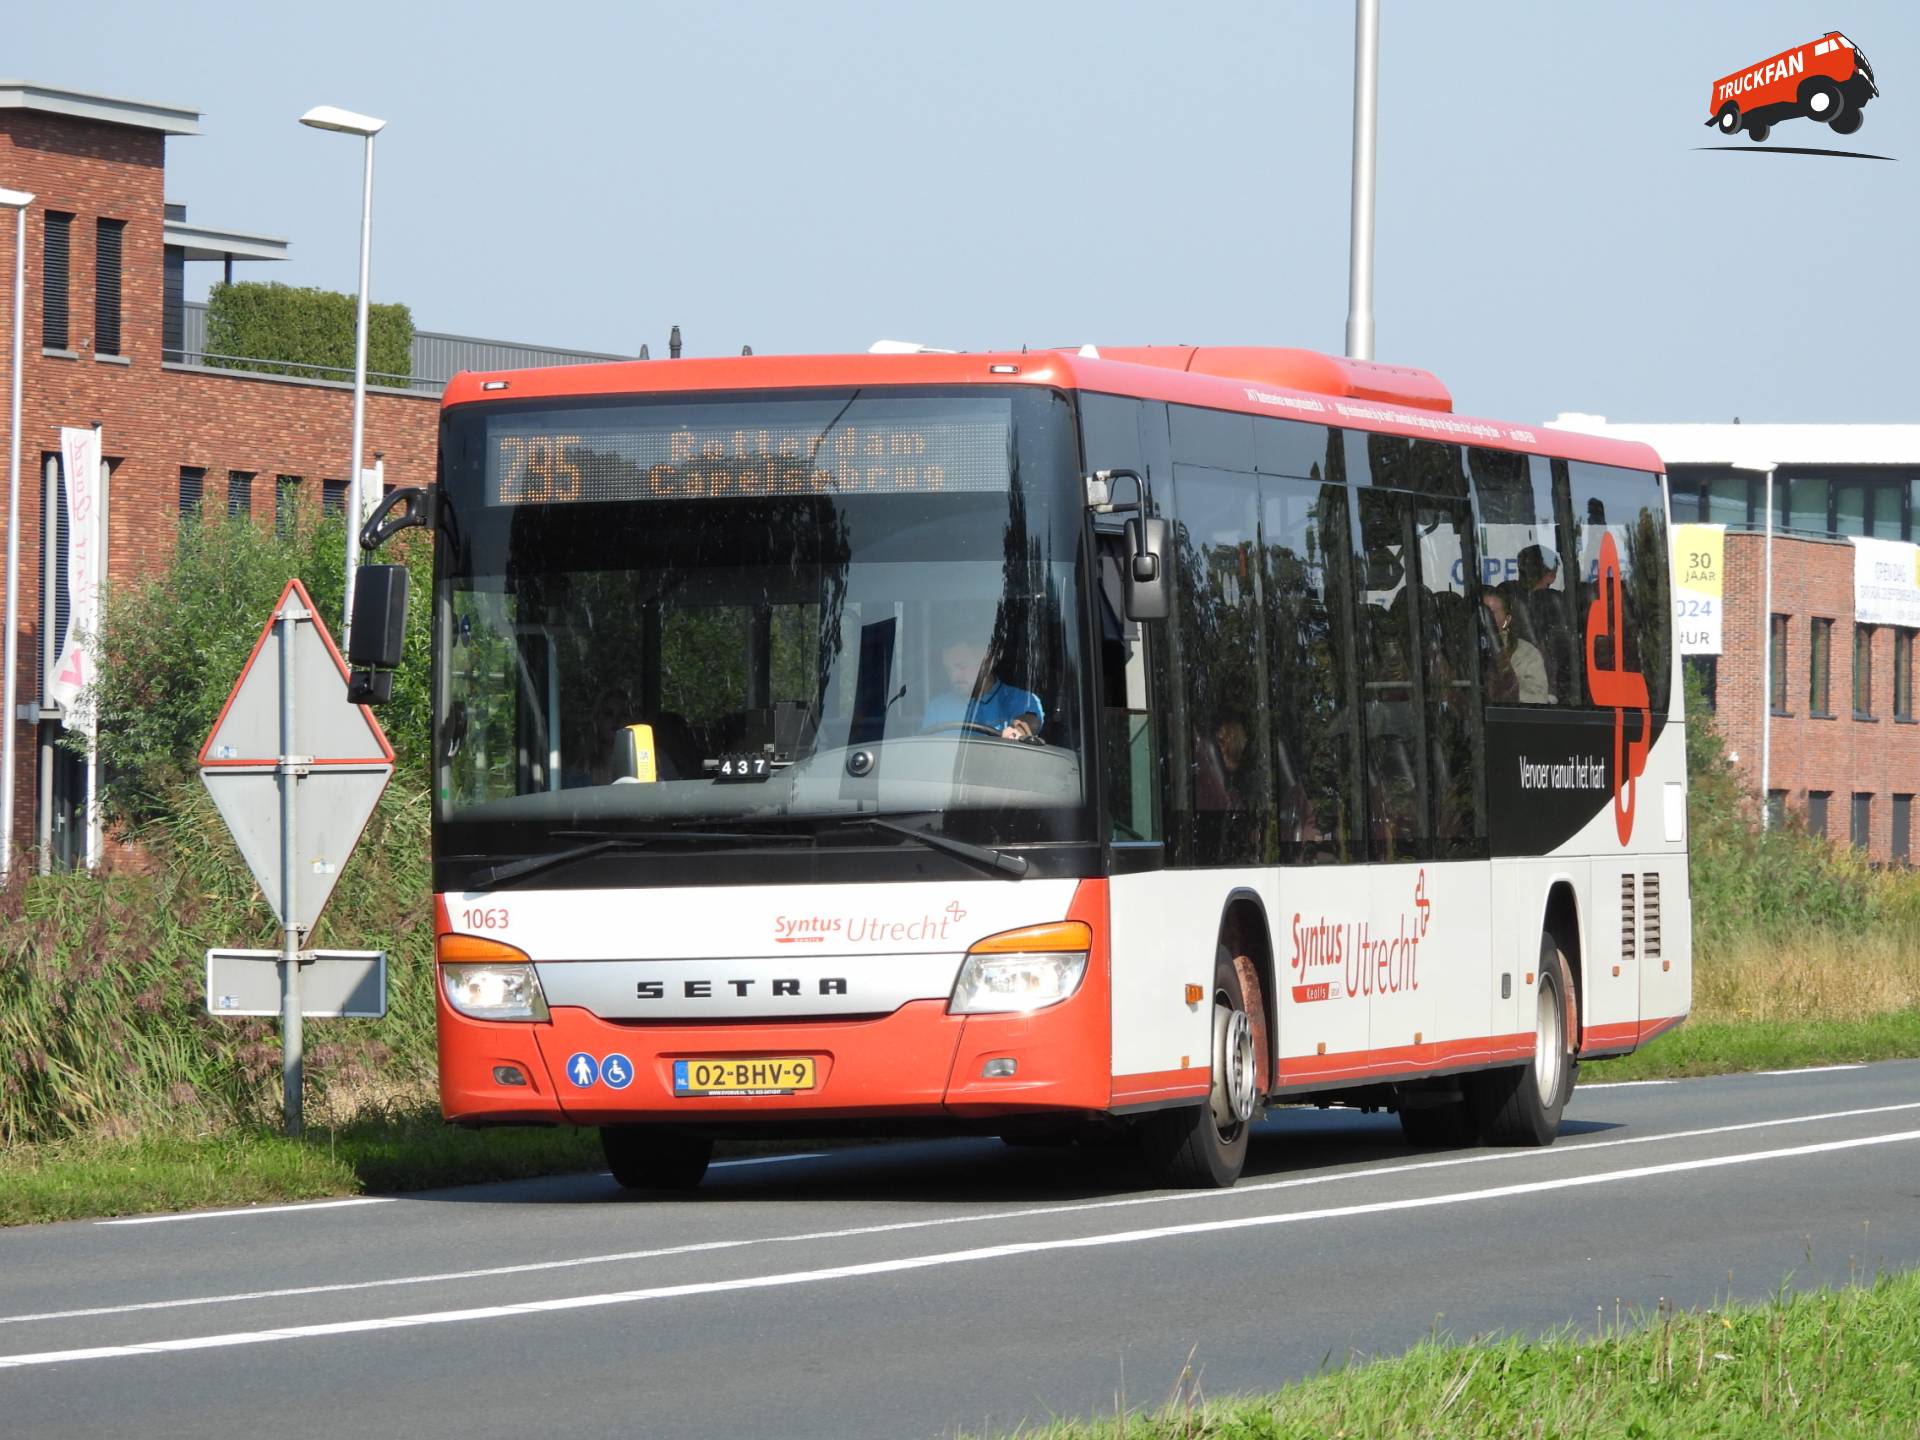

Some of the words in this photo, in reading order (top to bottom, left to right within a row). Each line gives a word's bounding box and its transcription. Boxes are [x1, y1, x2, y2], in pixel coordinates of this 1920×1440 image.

[671, 427, 926, 461] Rotterdam
[501, 436, 581, 502] 295
[649, 459, 945, 496] Capelsebrug
[1689, 552, 1711, 568] 30
[1684, 570, 1716, 583] JAAR
[1676, 600, 1712, 617] 024
[721, 759, 765, 775] 437
[1519, 755, 1549, 789] Vervoer
[1550, 756, 1575, 789] vanuit
[1576, 754, 1588, 789] het
[1589, 754, 1605, 789] hart
[462, 908, 509, 929] 1063
[775, 914, 842, 937] Syntus
[847, 914, 950, 942] Utrecht
[1291, 912, 1342, 984] Syntus
[1345, 913, 1419, 998] Utrecht
[637, 977, 848, 999] SETRA
[695, 1063, 806, 1086] 02-BHV-9
